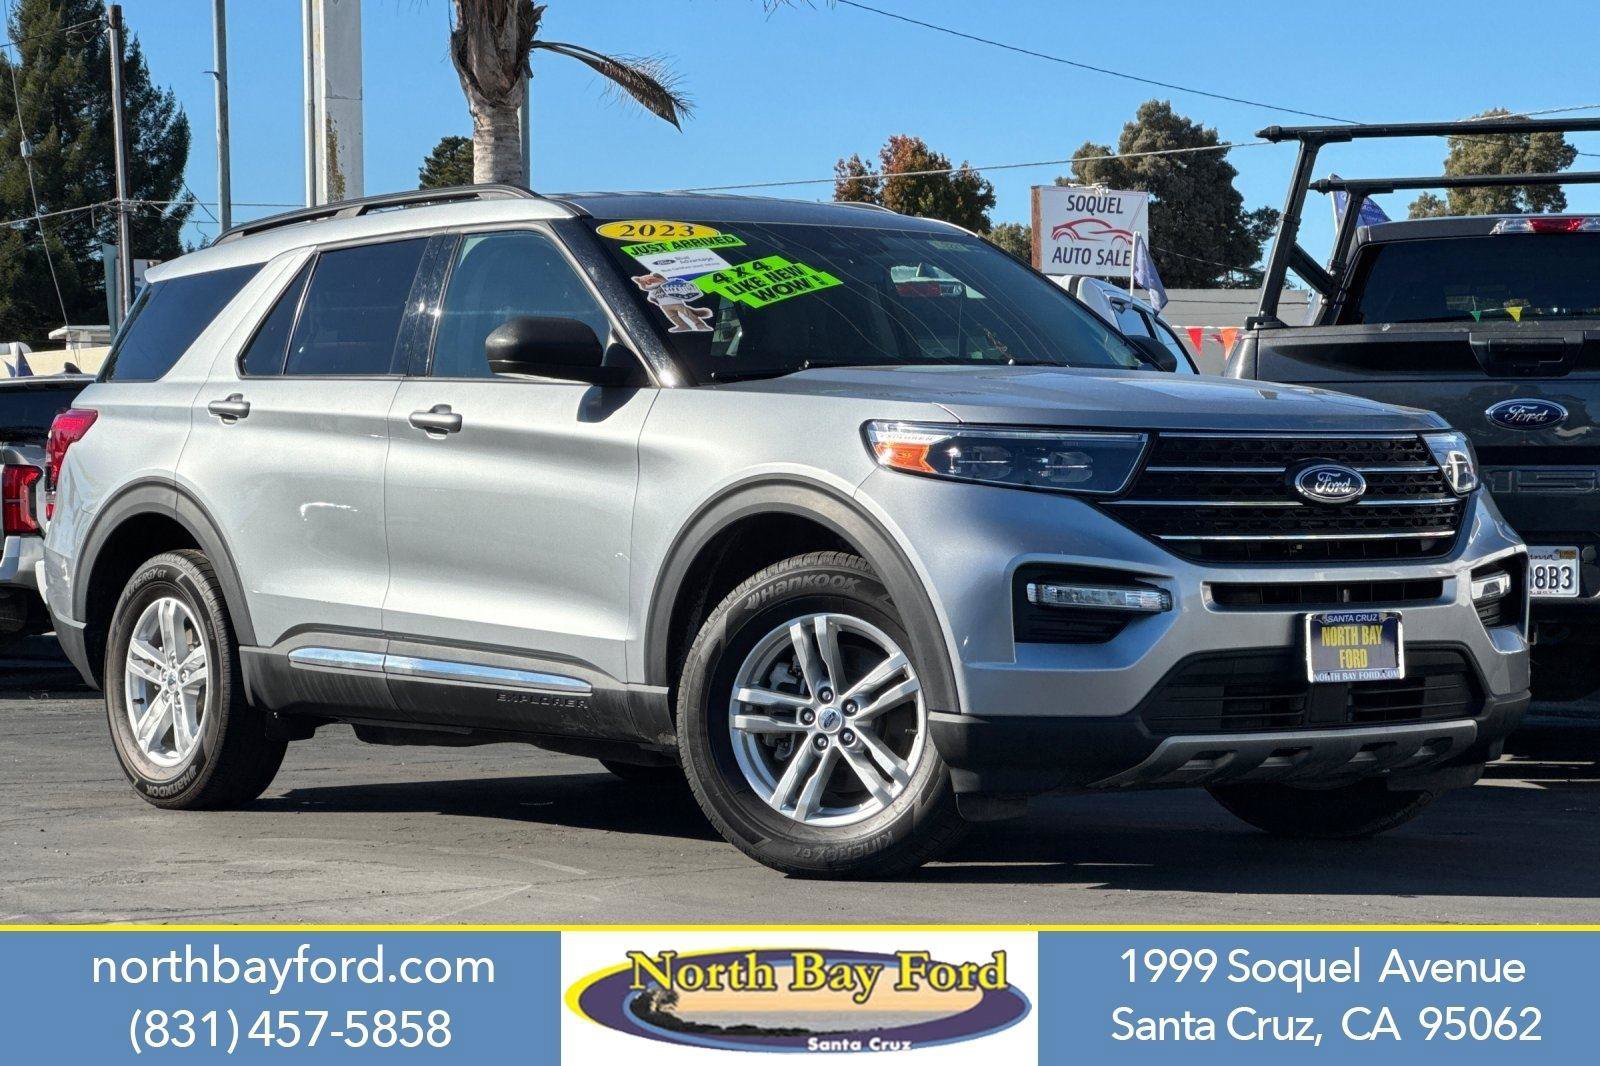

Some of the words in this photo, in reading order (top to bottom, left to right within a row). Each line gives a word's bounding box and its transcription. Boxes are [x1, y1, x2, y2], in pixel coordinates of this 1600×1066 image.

[1066, 195, 1123, 215] SOQUEL
[619, 224, 695, 236] 2023
[630, 242, 668, 256] JUST
[671, 235, 740, 251] ARRIVED
[1052, 247, 1091, 265] AUTO
[1096, 249, 1131, 266] SALE
[712, 271, 733, 284] 4
[752, 260, 773, 271] 4
[724, 276, 769, 296] LIKE
[762, 264, 808, 284] NEW
[1505, 405, 1549, 422] Ford
[1315, 472, 1352, 493] Ford
[1327, 614, 1354, 622] SANTA
[1355, 613, 1378, 622] CRUZ
[1322, 626, 1359, 646] NORTH
[1361, 625, 1383, 645] BAY
[1340, 648, 1368, 669] FORD
[1313, 672, 1340, 682] NORTH
[1342, 671, 1357, 681] BAY
